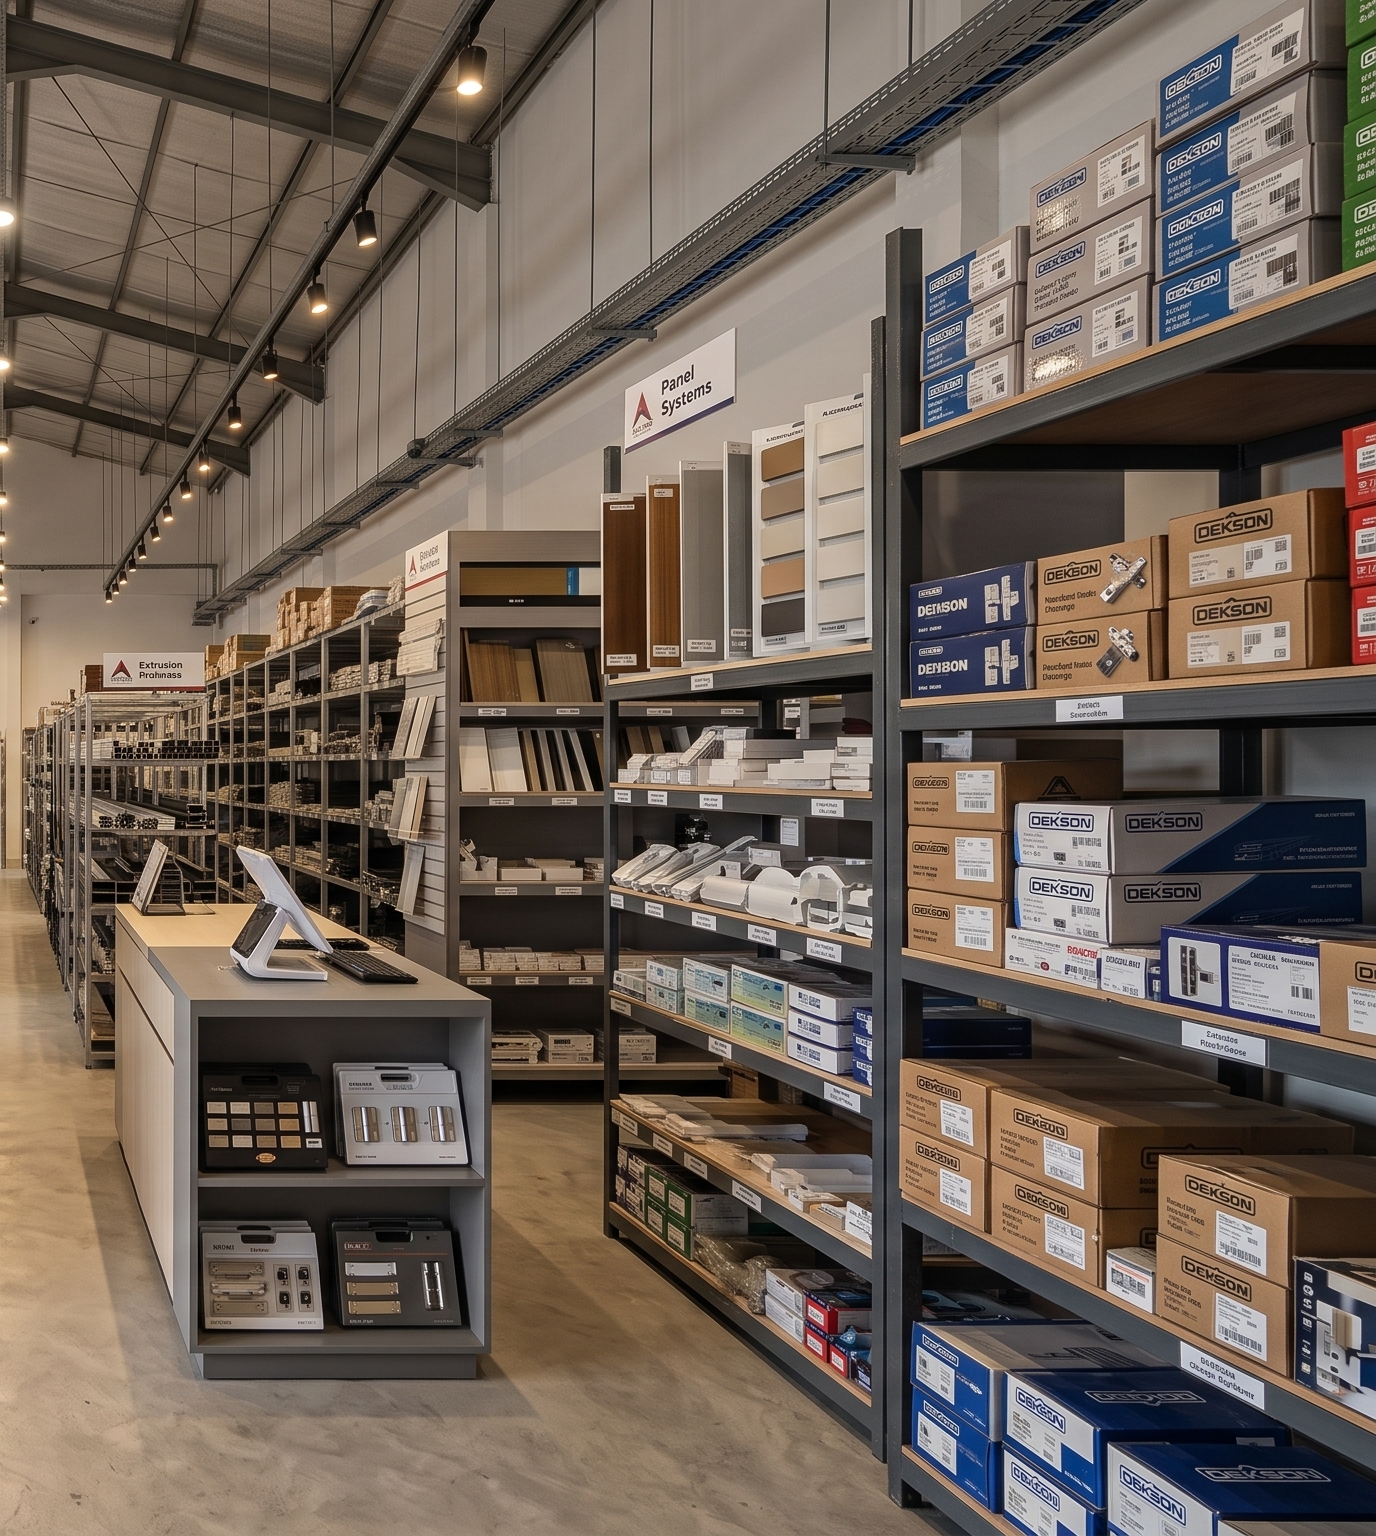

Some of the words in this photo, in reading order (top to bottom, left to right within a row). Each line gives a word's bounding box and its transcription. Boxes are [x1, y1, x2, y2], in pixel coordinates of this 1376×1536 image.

[662, 364, 695, 396] Panel
[662, 381, 712, 417] Systems
[1198, 513, 1268, 539] DEKSON
[1196, 601, 1267, 621] DEKSON
[1046, 634, 1096, 648] DEKSON
[139, 661, 183, 669] Extrusion
[1032, 816, 1091, 829] DEKSON
[1128, 816, 1199, 829] DEKSON
[1032, 881, 1091, 899] DEKSON
[1128, 886, 1198, 899] DEKSON
[1188, 1180, 1252, 1211] DEKSON
